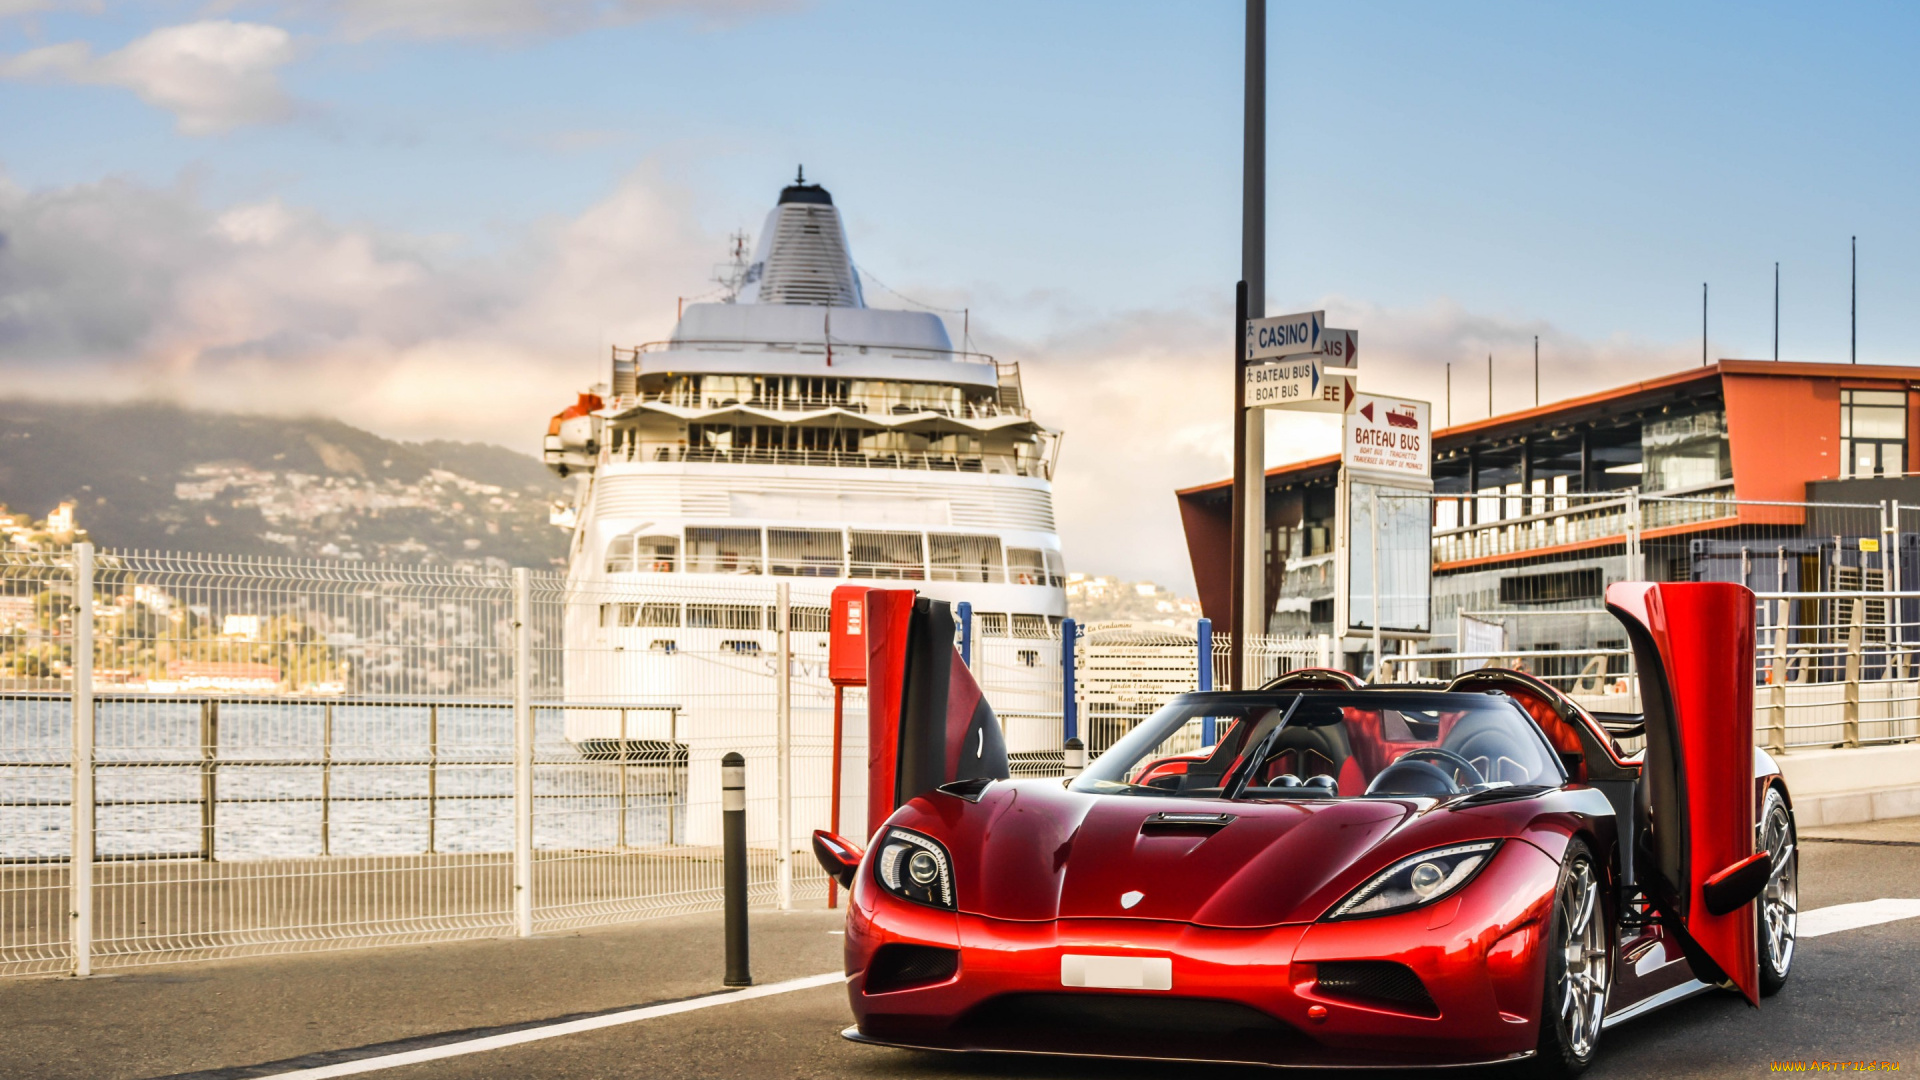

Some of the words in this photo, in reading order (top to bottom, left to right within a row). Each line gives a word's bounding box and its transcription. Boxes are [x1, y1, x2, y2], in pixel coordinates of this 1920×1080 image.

[1259, 322, 1308, 348] CASINO
[1320, 340, 1342, 356] AIS
[1256, 367, 1290, 383] BATEAU
[1293, 364, 1310, 379] BUS
[1256, 385, 1279, 400] BOAT
[1281, 384, 1299, 398] BUS
[1355, 428, 1396, 447] BATEAU
[1400, 433, 1420, 451] BUS
[1360, 447, 1373, 455] BOAT
[1386, 459, 1397, 467] PORT
[1405, 461, 1423, 470] MONACO
